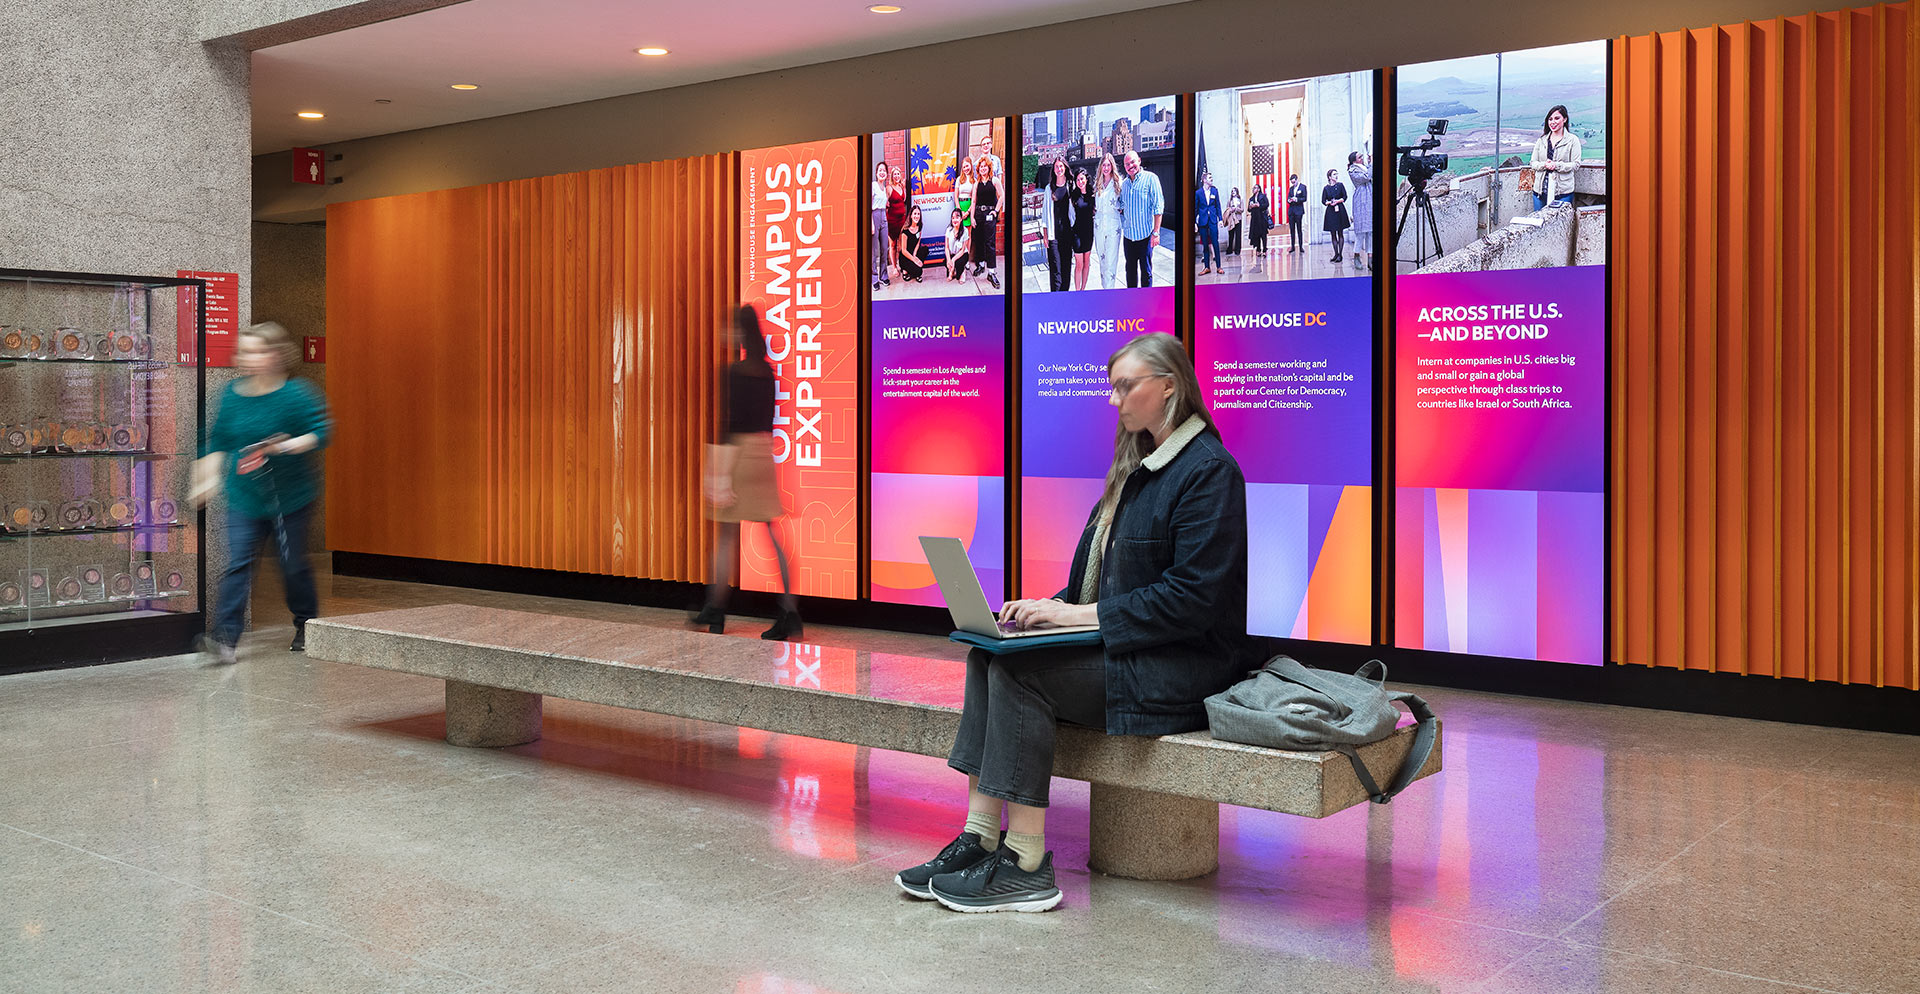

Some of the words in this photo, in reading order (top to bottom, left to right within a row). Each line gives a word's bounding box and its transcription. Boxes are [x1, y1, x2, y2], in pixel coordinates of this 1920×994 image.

[766, 163, 791, 464] OFF-CAMPUS
[796, 160, 822, 466] EXPERIENCES
[1418, 305, 1488, 322] ACROSS
[1491, 304, 1525, 320] THE
[1529, 303, 1563, 319] U.S.
[1038, 320, 1114, 334] NEWHOUSE
[1117, 318, 1144, 332] NYC
[1213, 313, 1301, 330] NEWHOUSE
[1304, 312, 1327, 326] DC
[883, 326, 950, 339] NEWHOUSE
[952, 325, 966, 337] LA
[1472, 324, 1548, 340] BEYOND
[180, 352, 190, 362] N1
[1417, 357, 1442, 366] Intern
[1454, 356, 1502, 367] companies
[1504, 356, 1512, 364] in
[1513, 355, 1532, 364] U.S.
[1534, 354, 1559, 364] cities
[1561, 354, 1576, 366] big
[883, 367, 901, 376] Spend
[950, 366, 974, 375] Angeles
[975, 365, 986, 373] and
[1068, 364, 1083, 372] York
[1084, 363, 1098, 373] City
[1214, 360, 1237, 371] Spend
[1280, 360, 1310, 370] working
[1312, 359, 1327, 368] and
[1214, 373, 1245, 384] studying
[1247, 374, 1253, 382] in
[1255, 373, 1267, 382] the
[1299, 372, 1325, 383] capital
[1327, 373, 1342, 381] and
[1343, 373, 1353, 381] be
[1417, 370, 1433, 380] and
[1434, 370, 1457, 380] small
[1470, 370, 1488, 381] gain
[1496, 369, 1524, 381] global
[923, 389, 942, 398] capital
[1220, 387, 1235, 397] part
[1236, 387, 1245, 395] of
[1260, 387, 1285, 395] Center
[1287, 386, 1298, 395] for
[1300, 386, 1347, 397] Democracy,
[1417, 385, 1467, 396] perspective
[1469, 384, 1504, 396] through
[1506, 384, 1527, 393] class
[1529, 385, 1550, 396] trips
[1213, 400, 1252, 410] Journalism
[1253, 400, 1267, 408] and
[1268, 399, 1313, 410] Citizenship.
[1417, 399, 1457, 408] countries
[1458, 399, 1474, 408] like
[1476, 399, 1499, 408] Israel
[1512, 398, 1540, 408] South
[1541, 398, 1572, 408] Africa.
